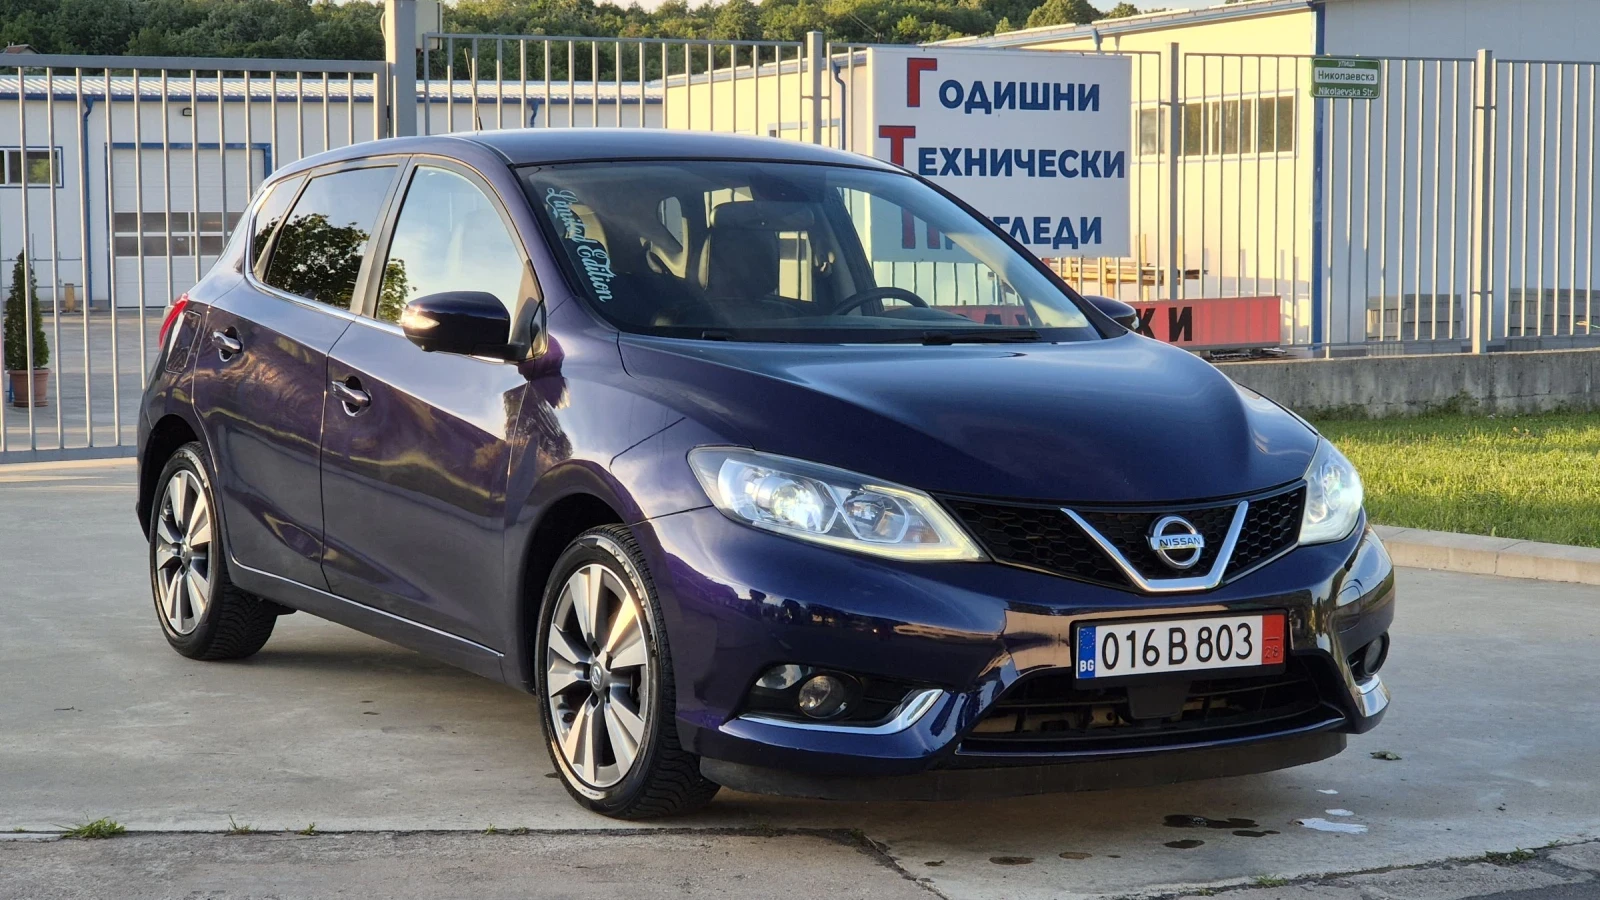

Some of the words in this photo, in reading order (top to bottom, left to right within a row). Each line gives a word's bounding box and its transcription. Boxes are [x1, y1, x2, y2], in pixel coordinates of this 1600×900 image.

[1318, 70, 1375, 82] Николаевска
[907, 57, 1100, 114] ГОДИШНИ
[1318, 87, 1361, 96] Nikolaevska
[1362, 88, 1375, 97] Str.
[879, 125, 1125, 178] ТЕХНИЧЕСКИ
[546, 187, 598, 243] Limited
[577, 245, 617, 302] Edition
[1159, 536, 1201, 547] NISSAN
[1080, 659, 1095, 672] BG
